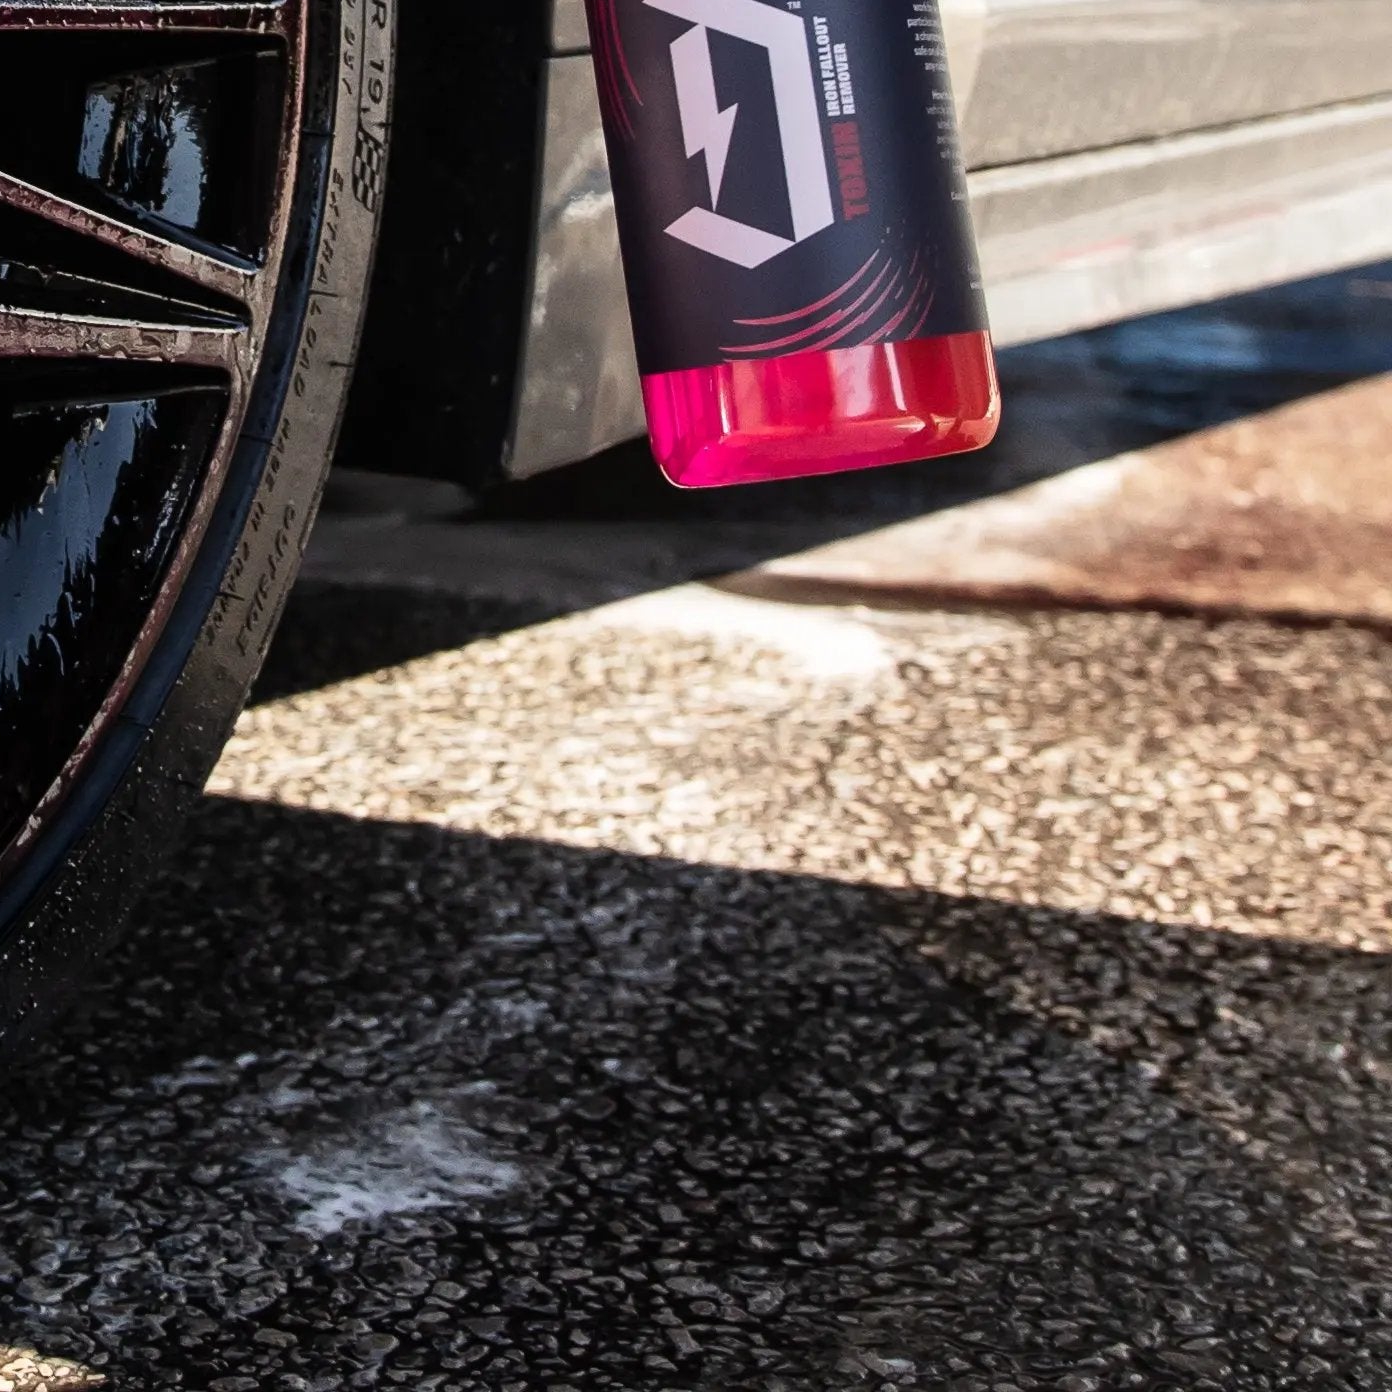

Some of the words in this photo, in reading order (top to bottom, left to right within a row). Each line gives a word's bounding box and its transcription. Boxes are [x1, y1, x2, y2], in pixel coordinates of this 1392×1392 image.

[812, 15, 836, 79] FALLOUT
[832, 42, 856, 115] REMOVER
[822, 79, 841, 117] IRON
